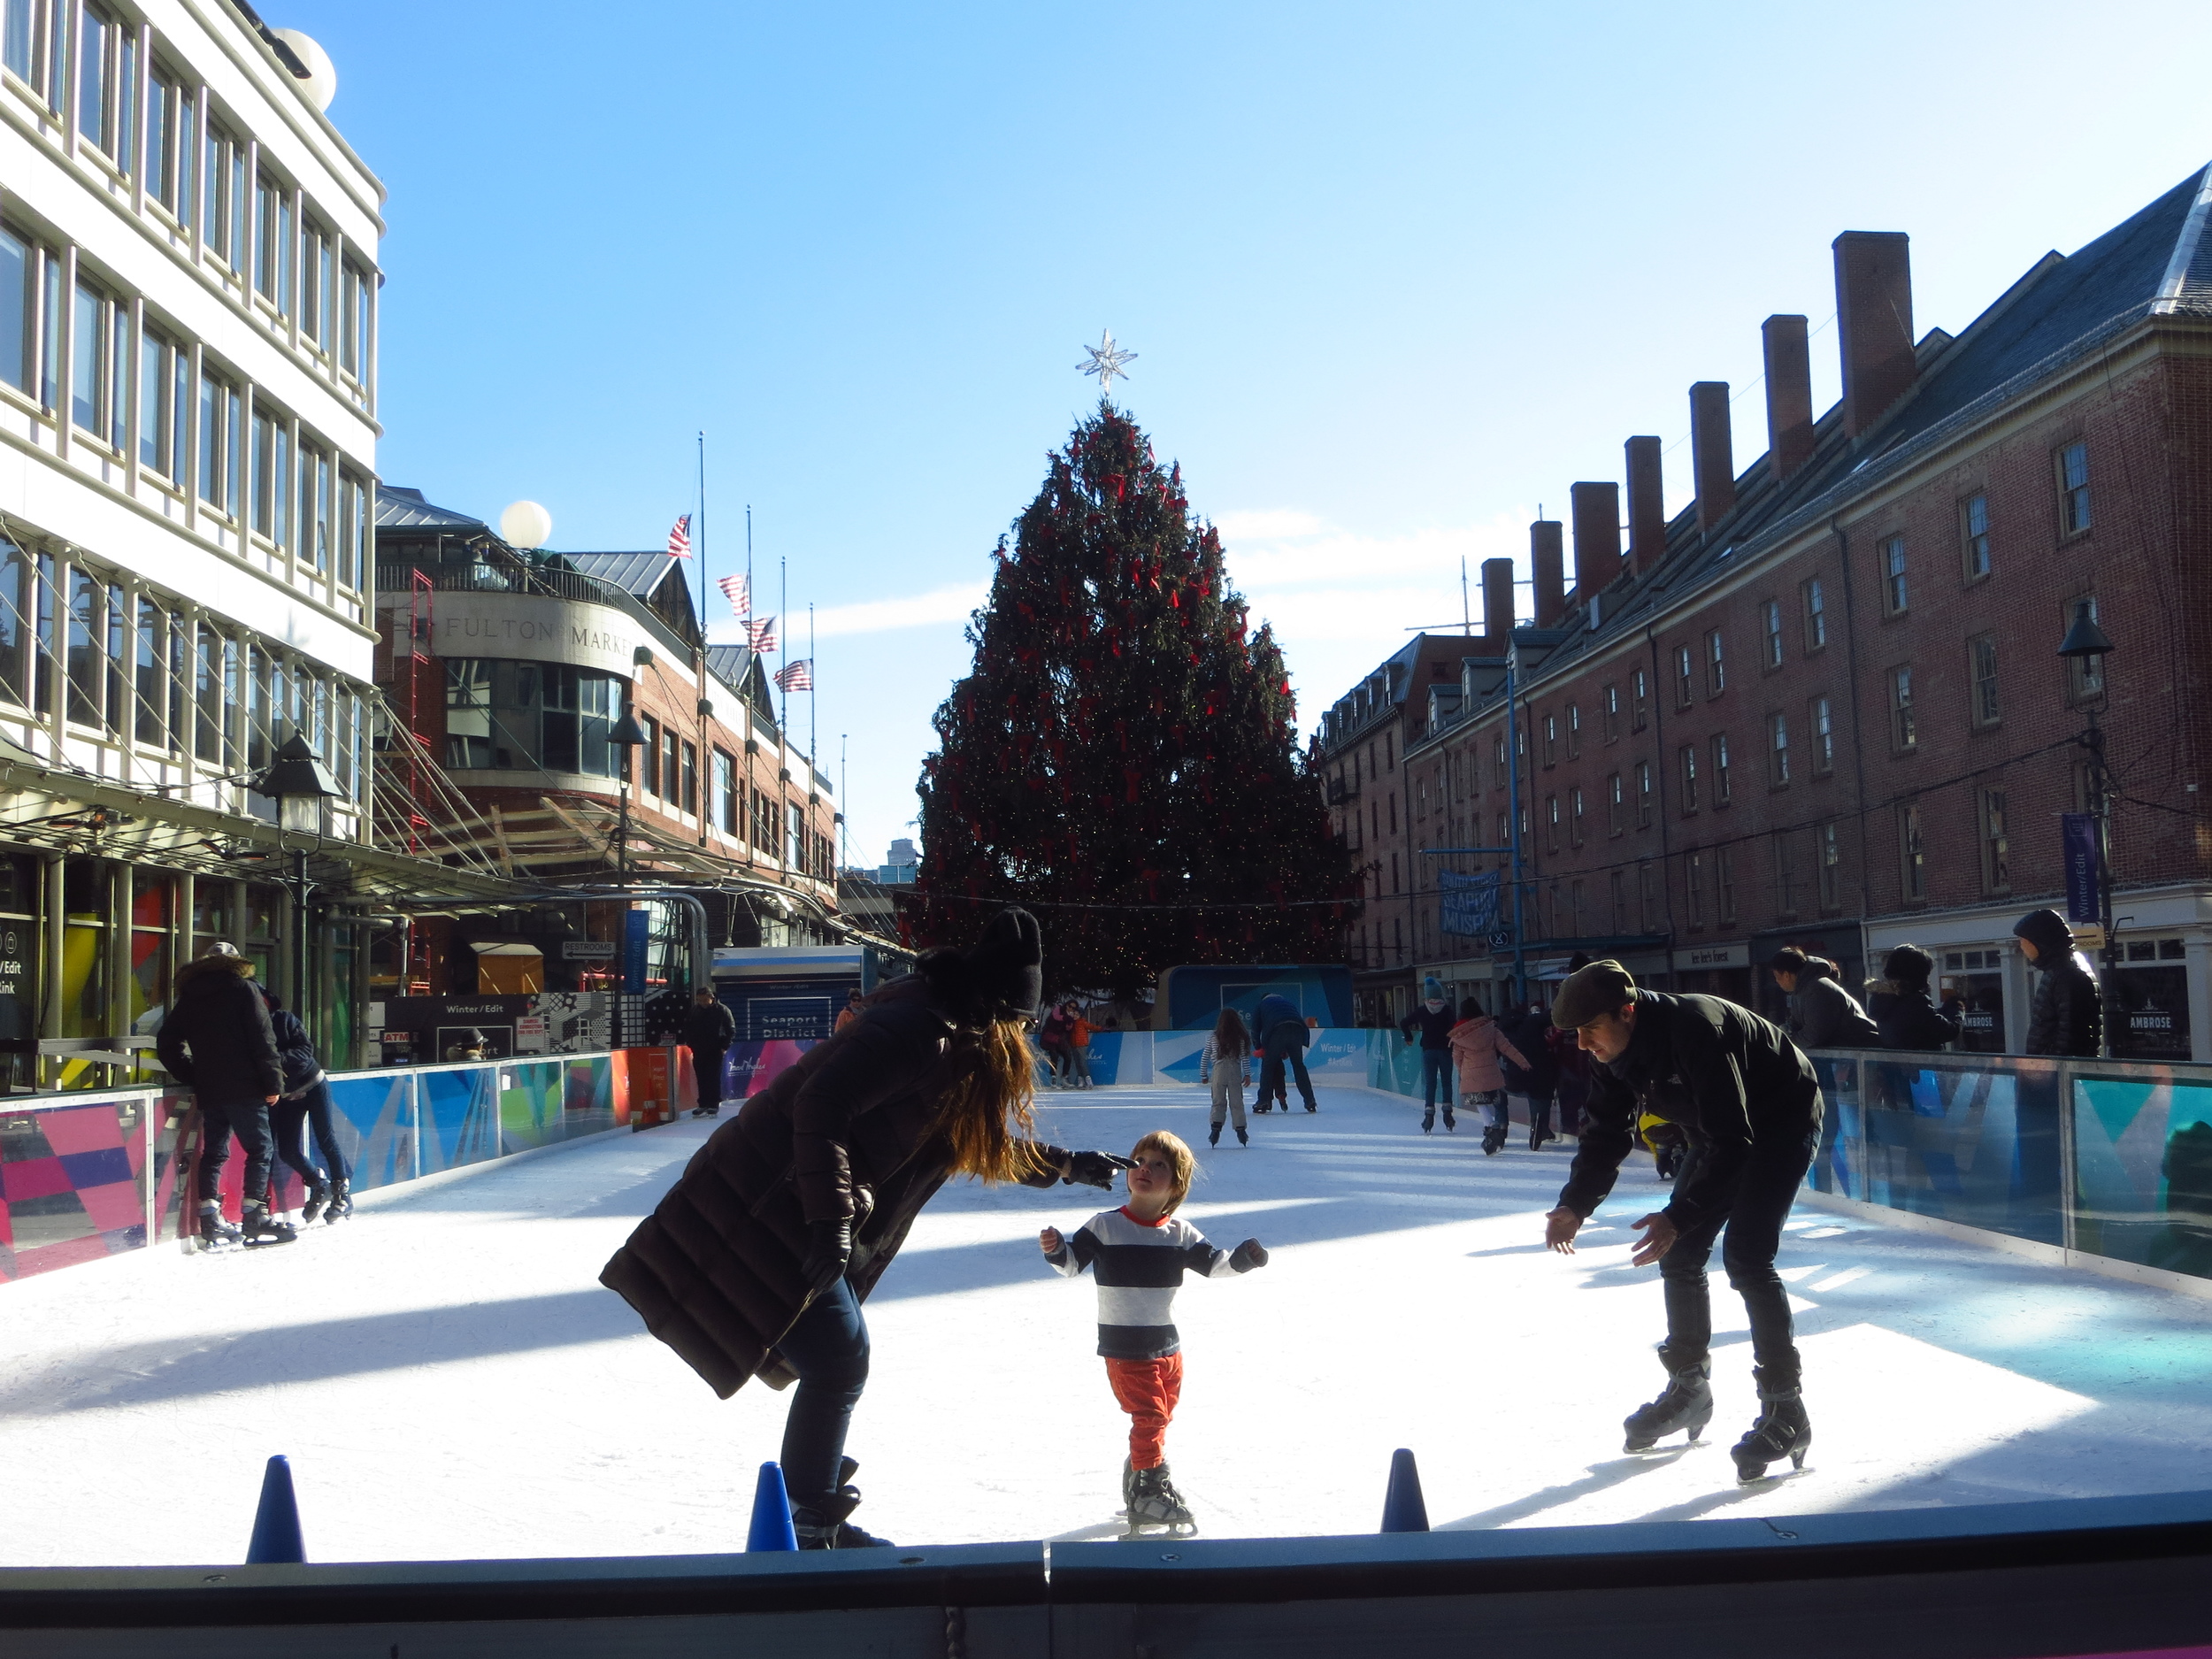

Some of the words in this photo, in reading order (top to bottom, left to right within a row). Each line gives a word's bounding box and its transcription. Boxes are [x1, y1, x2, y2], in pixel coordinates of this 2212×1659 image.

[445, 618, 554, 641] FULTON
[571, 626, 634, 659] MARKET
[2075, 853, 2089, 918] Winter/Edit
[1443, 910, 1499, 935] MUSEUM
[565, 942, 612, 952] RESTROOMS
[633, 940, 641, 990] Winter/Edit
[446, 1004, 478, 1013] Winter
[485, 1003, 504, 1013] Edit
[762, 1015, 818, 1026] Seaport
[1962, 1017, 1993, 1027] AMBROSE
[2131, 1017, 2171, 1029] AMBROSE
[384, 1033, 410, 1042] ATM
[763, 1029, 817, 1038] District
[1321, 1043, 1343, 1053] Winter
